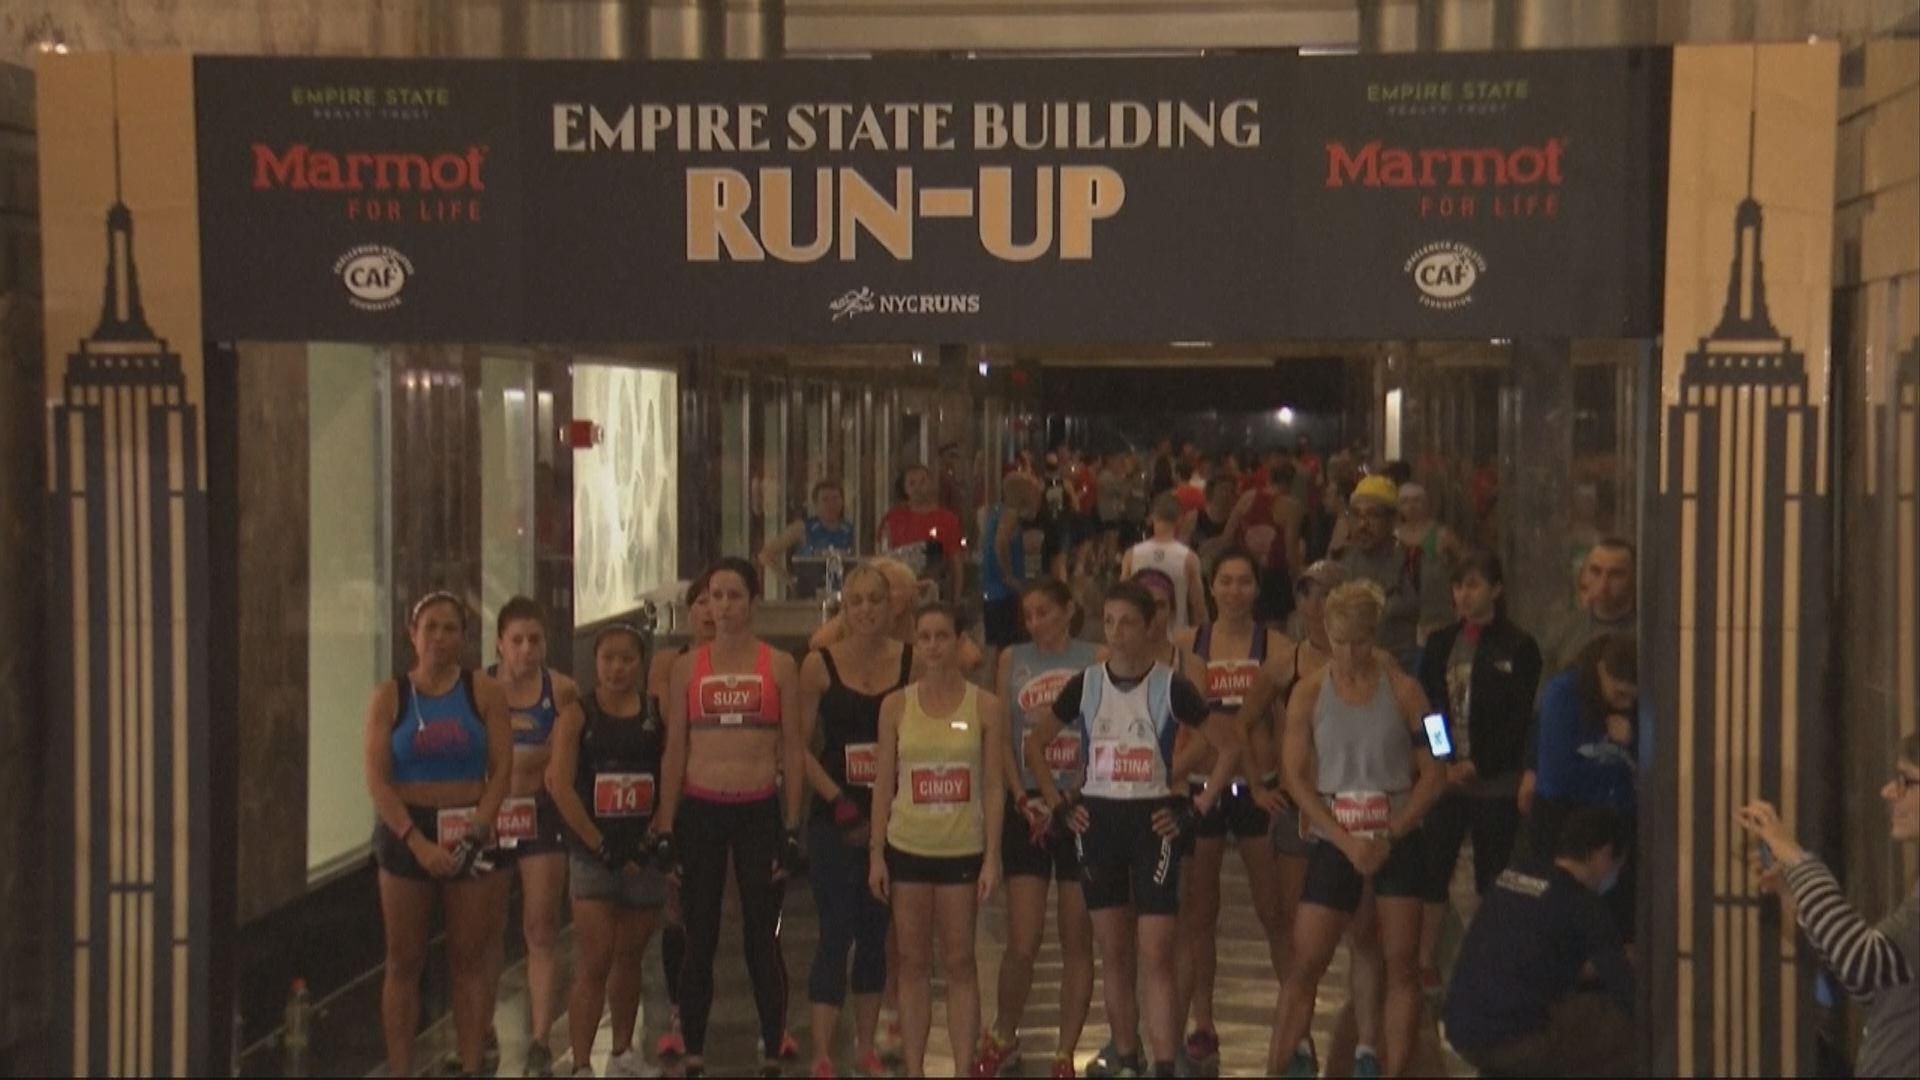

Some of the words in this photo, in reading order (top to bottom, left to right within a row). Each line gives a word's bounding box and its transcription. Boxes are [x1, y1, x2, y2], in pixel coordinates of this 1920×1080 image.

[292, 86, 376, 105] EMPIRE
[385, 86, 448, 105] STATE
[1367, 82, 1452, 102] EMPIRE
[1462, 80, 1529, 100] STATE
[553, 103, 770, 152] EMPIRE
[786, 102, 955, 151] STATE
[973, 100, 1262, 150] BUILDING
[251, 143, 485, 191] Marmot
[1324, 136, 1564, 188] Marmot
[348, 199, 400, 221] FOR
[421, 199, 481, 221] LIFE
[685, 166, 1126, 262] RUN-UP
[1419, 196, 1475, 218] FOR
[1494, 194, 1559, 218] LIFE
[350, 267, 396, 288] CAF
[1420, 264, 1466, 286] CAF
[879, 294, 980, 313] NYCRUNS
[713, 690, 750, 706] SUZY
[918, 779, 963, 796] CINDY
[613, 788, 638, 810] 14
